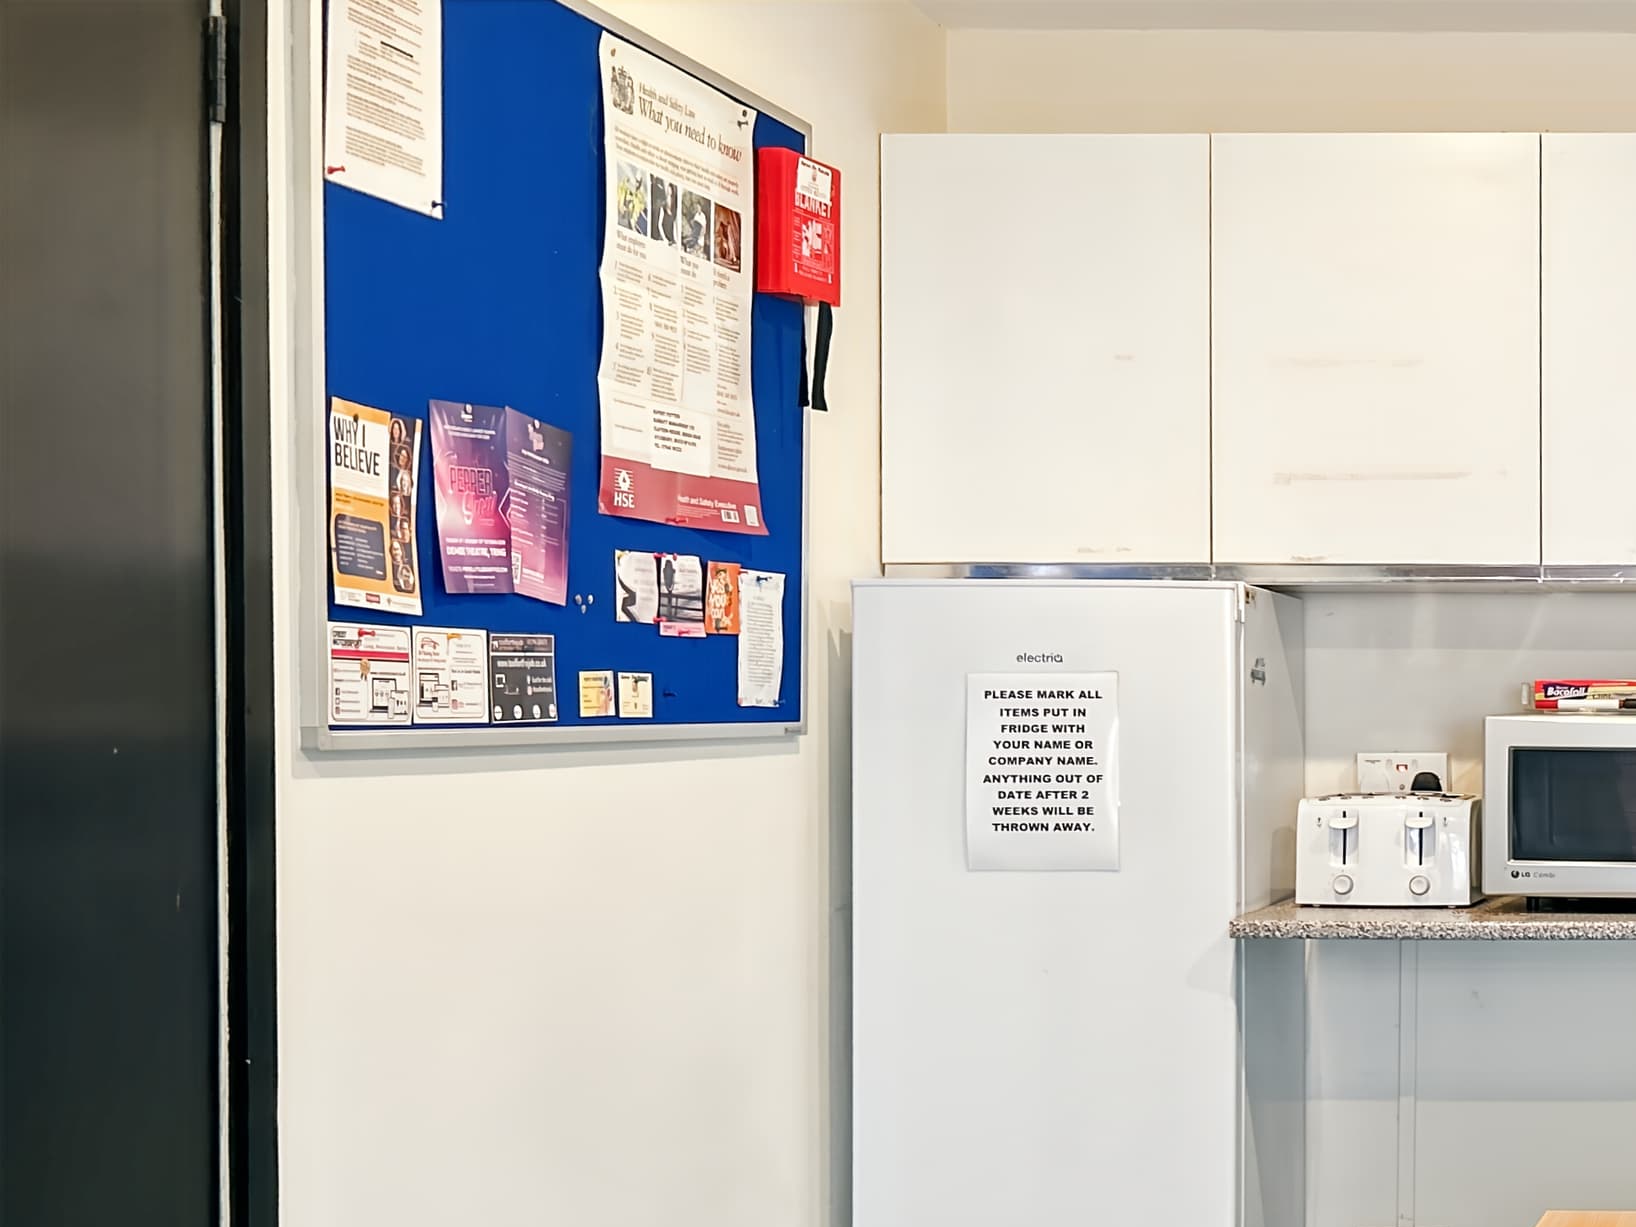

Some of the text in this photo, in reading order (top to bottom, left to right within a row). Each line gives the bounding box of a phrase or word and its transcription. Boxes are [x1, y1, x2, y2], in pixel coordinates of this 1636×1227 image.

[638, 95, 742, 162] What you need to know
[333, 415, 366, 448] WHY I
[334, 442, 381, 477] BELIEVE
[613, 492, 636, 509] HSE
[984, 690, 1103, 700] PLEASE MARK ALL
[999, 708, 1087, 717] ITEMS PUT IN
[1000, 724, 1086, 734] FRIDGE WITH
[993, 740, 1093, 750] YOUR NAME OR
[988, 756, 1098, 766] COMPANY NAME.
[982, 774, 1104, 784] ANYTHING OUT OF
[997, 790, 1090, 800] DATE AFTER 2
[992, 806, 1094, 816] WEEKS WILL BE
[991, 822, 1095, 832] THROWN AWAY.
